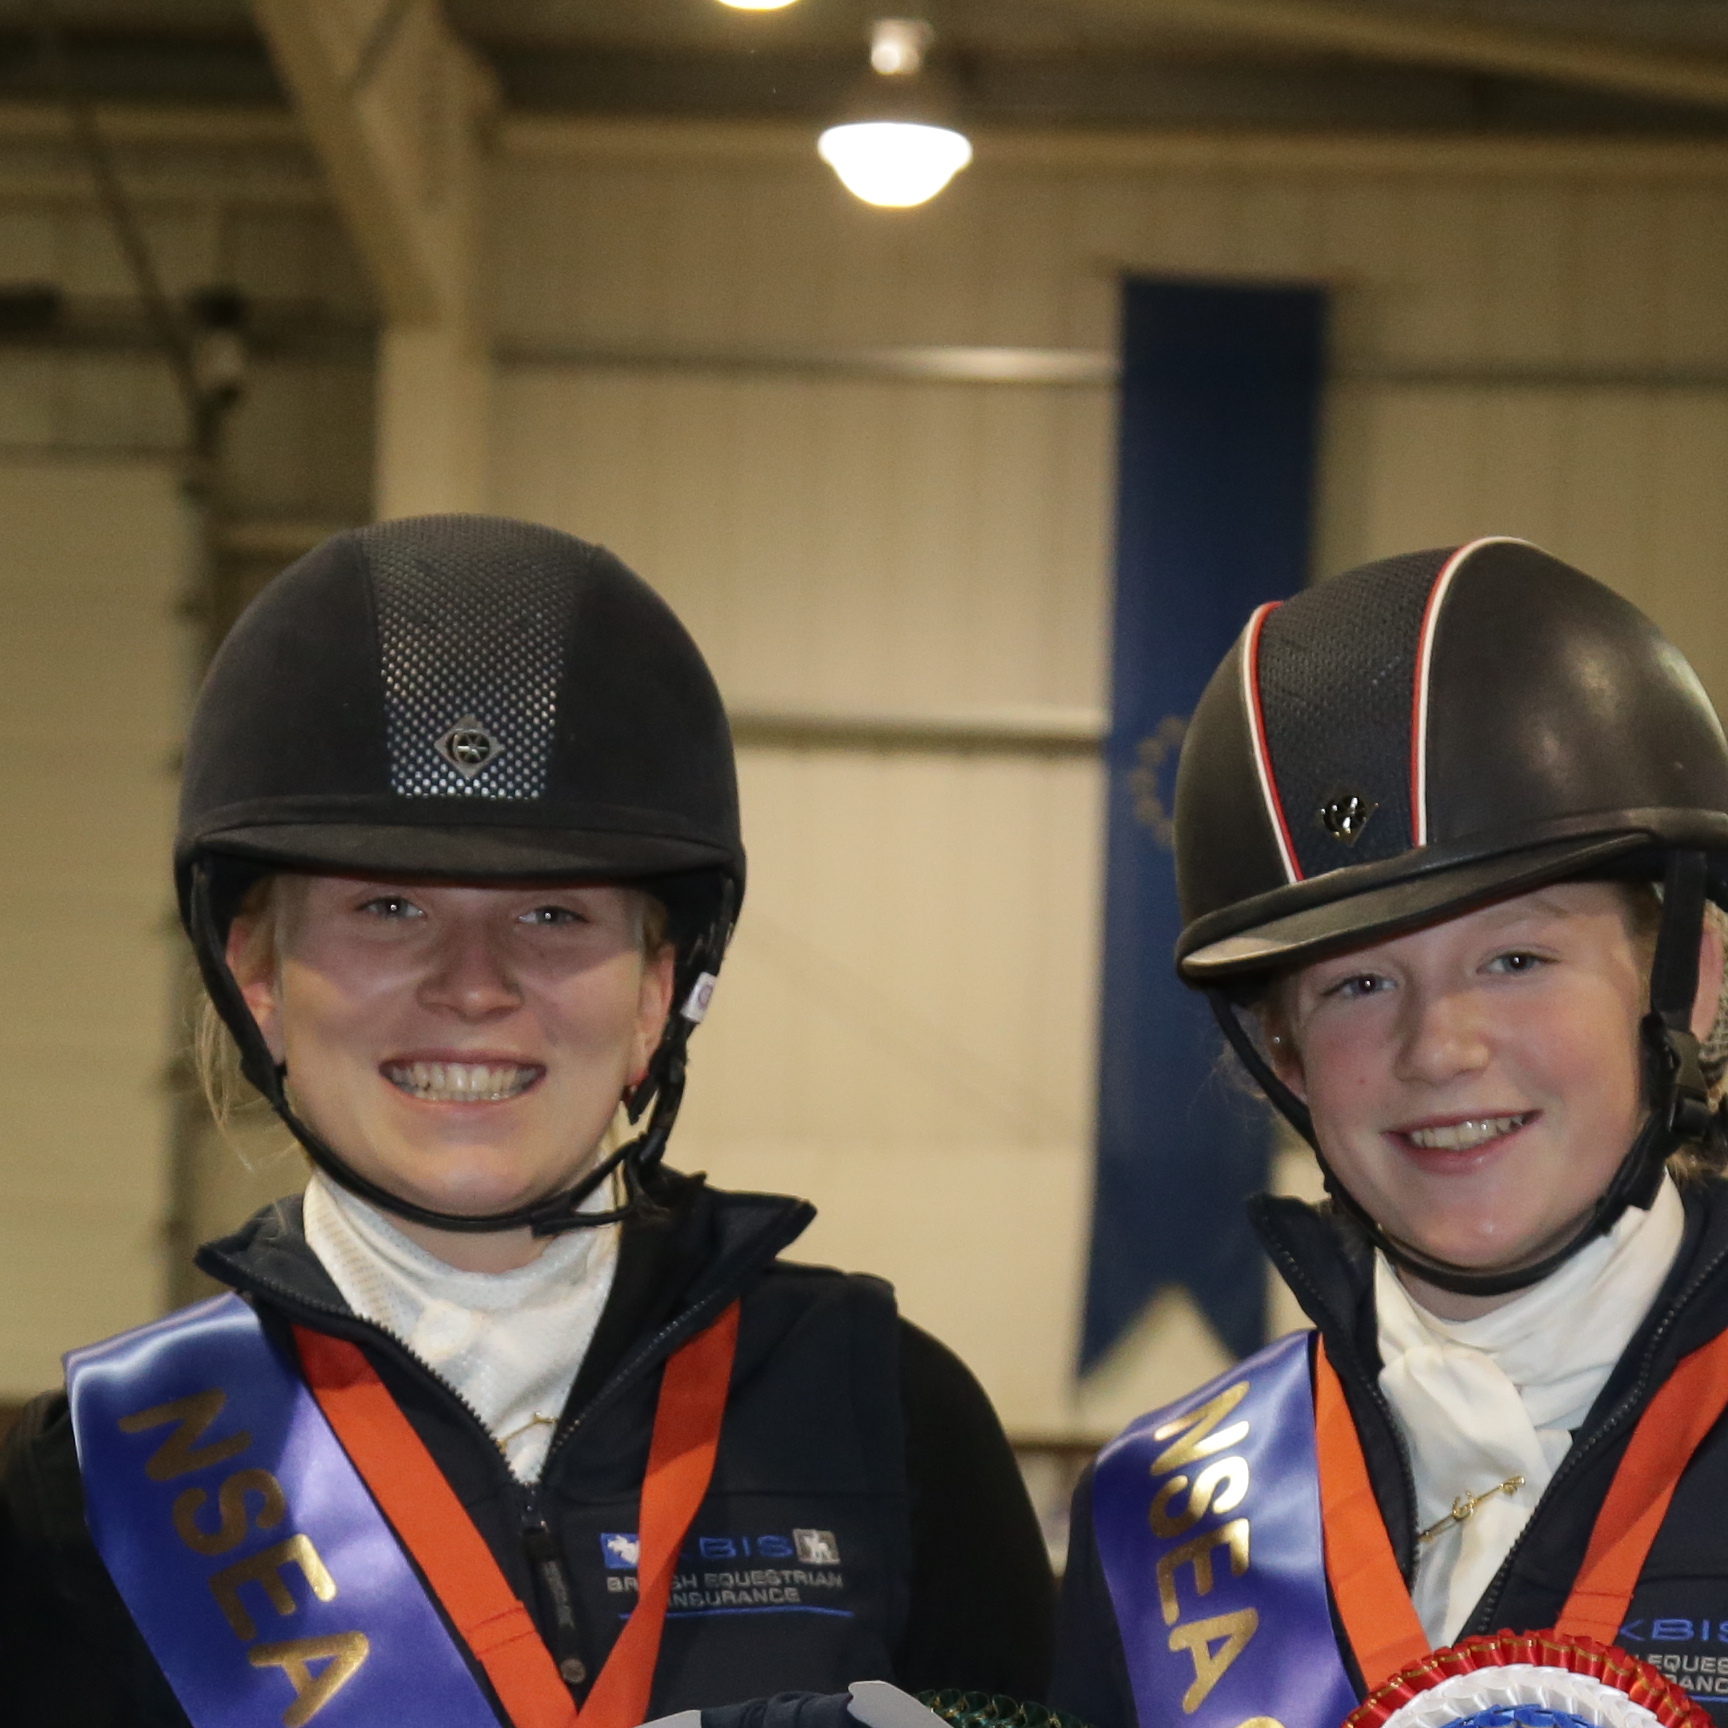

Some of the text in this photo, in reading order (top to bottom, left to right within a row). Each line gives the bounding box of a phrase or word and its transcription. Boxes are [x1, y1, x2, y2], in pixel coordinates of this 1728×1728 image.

[606, 1568, 844, 1593] BRSH EQUESTRIAN
[1150, 1381, 1260, 1715] NSEA
